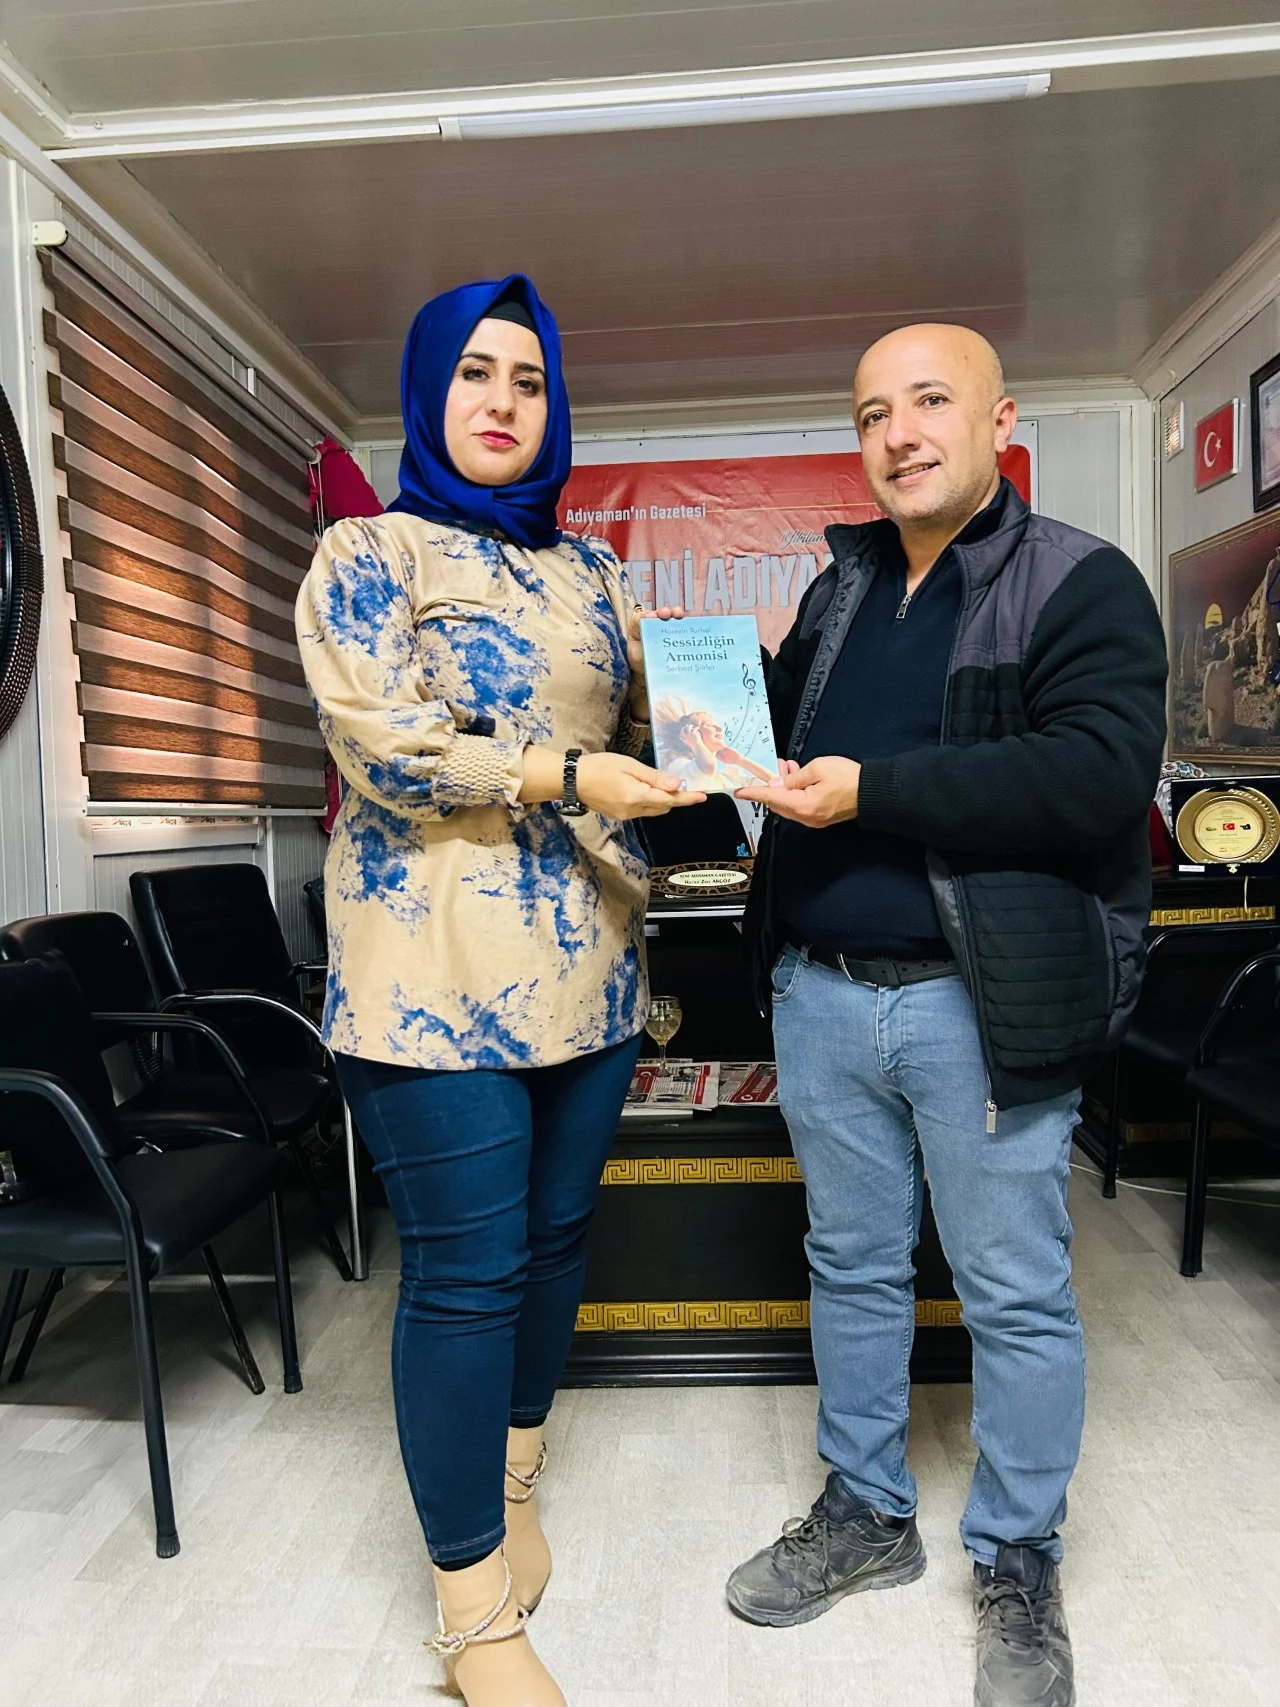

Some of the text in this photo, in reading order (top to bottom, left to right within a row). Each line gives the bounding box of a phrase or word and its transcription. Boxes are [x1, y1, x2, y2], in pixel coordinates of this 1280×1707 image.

[565, 502, 706, 525] Adıyaman'ın Gazetesi
[703, 552, 835, 611] ADIYA
[662, 636, 735, 649] Sessizliğin
[666, 650, 728, 662] Armonisi
[666, 664, 716, 672] Serbest Şiirler
